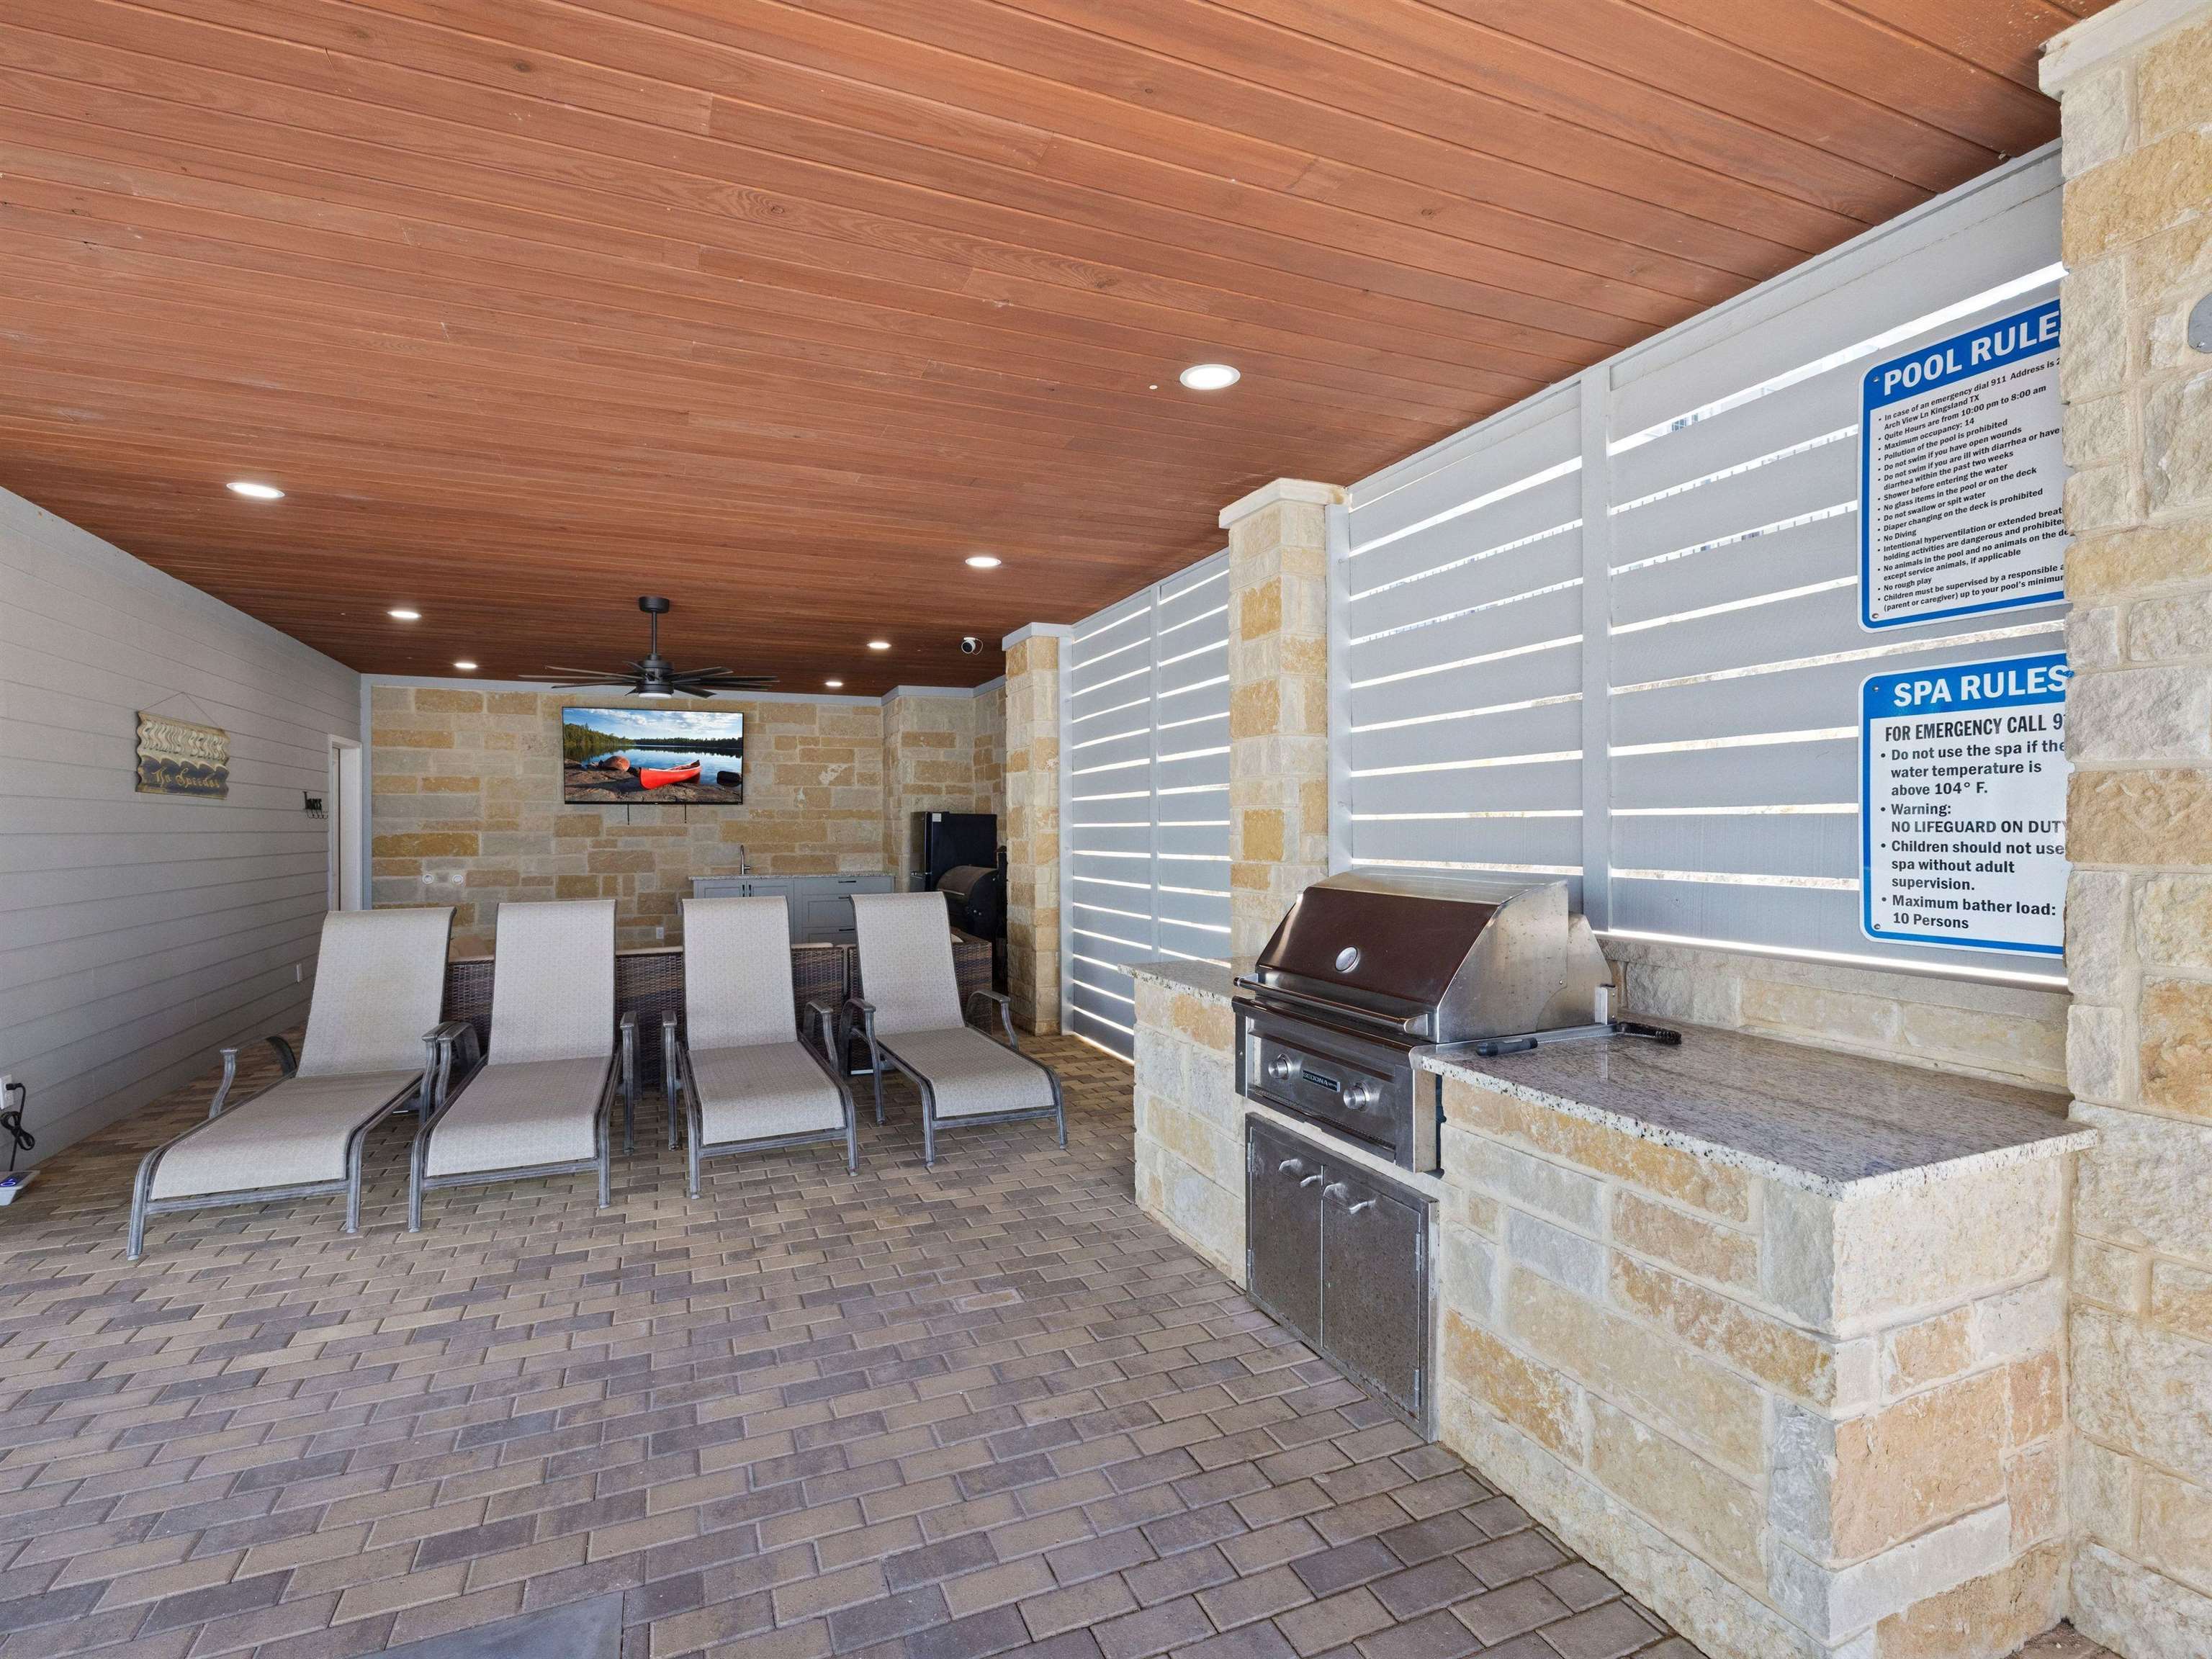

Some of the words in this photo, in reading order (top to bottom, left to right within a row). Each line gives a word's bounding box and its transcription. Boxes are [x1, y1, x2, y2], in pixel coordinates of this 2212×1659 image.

[1884, 349, 1962, 396] POOL
[1971, 310, 2059, 366] RULE
[1893, 408, 1910, 418] case
[1931, 388, 1972, 407] emergency
[1974, 381, 1989, 392] dial
[1991, 376, 2006, 386] 911
[2010, 364, 2045, 380] Address
[1884, 421, 1900, 430] Arch
[1902, 414, 1918, 425] View
[1930, 398, 1968, 415] Kingsland
[1969, 394, 1979, 403] TX
[1884, 431, 1903, 441] Quite
[1905, 423, 1925, 434] Hours
[1941, 413, 1959, 423] from
[1961, 404, 1984, 416] 10:00
[1986, 400, 1999, 410] pm
[2010, 389, 2031, 401] 8:00
[2033, 385, 2046, 395] am
[1884, 436, 1918, 450] Maximum
[1920, 423, 1963, 440] occupancy:
[1964, 418, 1974, 426] 14
[1884, 446, 1915, 461] Pollution
[1926, 440, 1938, 449] the
[1940, 434, 1956, 446] pool
[1966, 418, 2008, 439] prohibited
[1894, 459, 1907, 468] not
[1907, 454, 1926, 464] swim
[1934, 449, 1948, 459] you
[1949, 442, 1967, 453] have
[1969, 436, 1989, 447] open
[1990, 427, 2022, 441] wounds
[1907, 464, 1926, 475] swim
[1934, 459, 1948, 469] you
[1973, 446, 1990, 457] with
[1992, 437, 2027, 451] diarrhea
[2039, 428, 2060, 439] have
[1884, 478, 1913, 490] diarrhea
[1915, 472, 1937, 482] within
[1953, 462, 1971, 473] past
[1972, 459, 1986, 467] two
[1987, 451, 2014, 462] weeks
[1884, 490, 1910, 501] Shower
[1911, 483, 1935, 494] before
[1936, 474, 1969, 487] entering
[1984, 464, 2008, 475] water
[1894, 498, 1913, 510] glass
[1915, 493, 1936, 503] items
[1960, 482, 1977, 493] pool
[2016, 467, 2037, 477] deck
[1884, 521, 1907, 532] Diaper
[1908, 513, 1943, 526] changing
[1955, 506, 1968, 515] the
[1969, 501, 1989, 512] deck
[2000, 487, 2044, 505] prohibited
[1894, 511, 1907, 519] not
[1907, 503, 1936, 516] swallow
[1947, 497, 1962, 506] spit
[1963, 492, 1986, 502] water
[1884, 537, 1923, 552] Intentional
[1924, 524, 1986, 544] hyperventilation
[1997, 512, 2036, 527] extended
[1884, 550, 1910, 562] holding
[1911, 543, 1945, 555] activities
[1961, 531, 2002, 545] dangerous
[2005, 526, 2020, 536] and
[1894, 529, 1917, 540] Diving
[1884, 572, 1907, 581] except
[1908, 566, 1934, 577] service
[1978, 549, 2021, 563] applicable
[1894, 559, 1923, 570] animals
[1947, 549, 1964, 559] pool
[1965, 546, 1980, 555] and
[1994, 537, 2027, 549] animals
[2041, 531, 2056, 540] the
[1884, 590, 1913, 601] Children
[1915, 587, 1933, 595] must
[1946, 577, 1988, 590] supervised
[2008, 565, 2058, 579] responsible
[1894, 580, 1915, 588] rough
[1916, 577, 1932, 586] play
[1884, 601, 1910, 612] (parent
[1920, 592, 1959, 605] caregiver)
[1981, 586, 1999, 595] your
[1893, 678, 1952, 707] SPA
[1961, 665, 2069, 701] RULES
[1885, 725, 1911, 742] FOR
[1915, 718, 2002, 739] EMERGENCY
[2007, 714, 2047, 734] CALL
[2053, 712, 2065, 730] 9
[1892, 749, 1908, 761] Do
[1912, 747, 1935, 760] not
[1938, 747, 1963, 758] use
[1966, 744, 1991, 757] the
[1995, 744, 2022, 759] spa
[2026, 740, 2038, 754] if
[2041, 739, 2065, 752] the
[1891, 765, 1929, 778] water
[1931, 762, 2025, 778] temperature
[2028, 760, 2042, 773] is
[1891, 785, 1930, 796] above
[1934, 782, 1971, 795] 104°
[1976, 782, 1988, 794] F.
[1891, 804, 1951, 817] Warning:
[1891, 821, 1910, 833] NO
[1914, 821, 1997, 834] LIFEGUARD
[2000, 821, 2023, 833] ON
[1891, 840, 1949, 853] Children
[1952, 841, 2002, 854] should
[2005, 842, 2031, 855] not
[2036, 844, 2065, 855] use
[1892, 860, 1915, 872] spa
[1918, 859, 1972, 873] without
[1975, 860, 2015, 873] adult
[1892, 877, 1975, 891] supervision.
[1892, 894, 1959, 909] Maximum
[1962, 899, 2013, 914] bather
[2016, 902, 2056, 916] load:
[1893, 912, 1909, 924] 10
[1913, 914, 1969, 929] Persons
